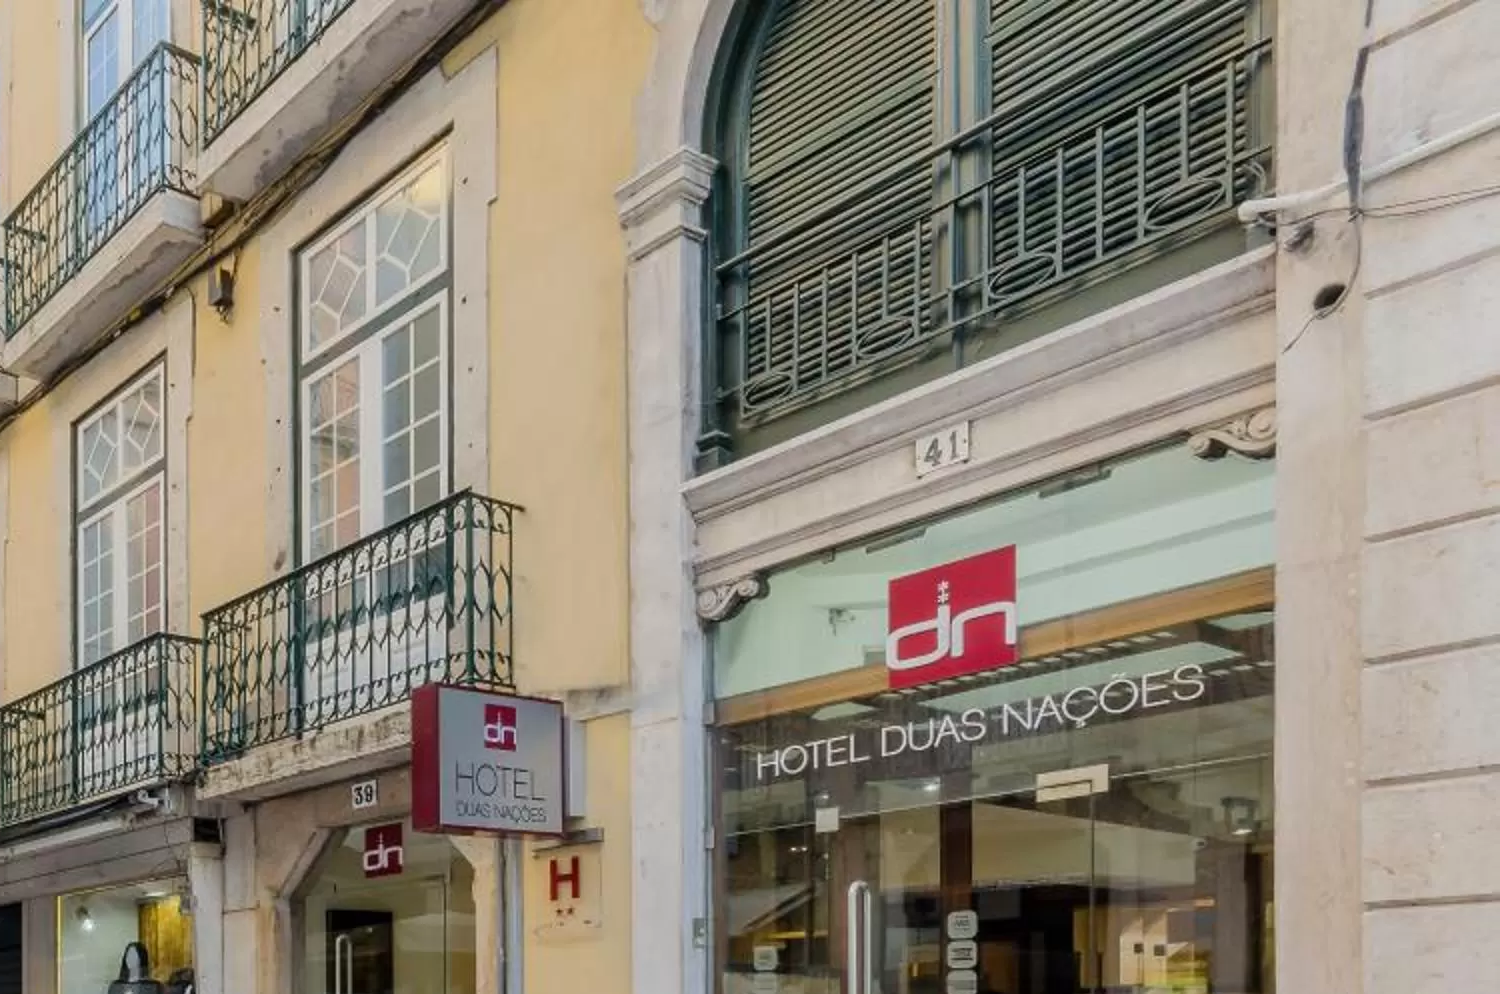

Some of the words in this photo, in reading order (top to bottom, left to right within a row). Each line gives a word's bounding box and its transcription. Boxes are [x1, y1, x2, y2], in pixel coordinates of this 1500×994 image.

[924, 428, 961, 466] 41
[755, 734, 869, 780] HOTEL
[880, 707, 987, 757] DUAS
[1002, 664, 1206, 734] NAÇÕES
[455, 759, 546, 801] HOTEL
[456, 800, 492, 818] DUAS
[494, 804, 548, 824] NAÇÕES
[549, 856, 580, 901] H
